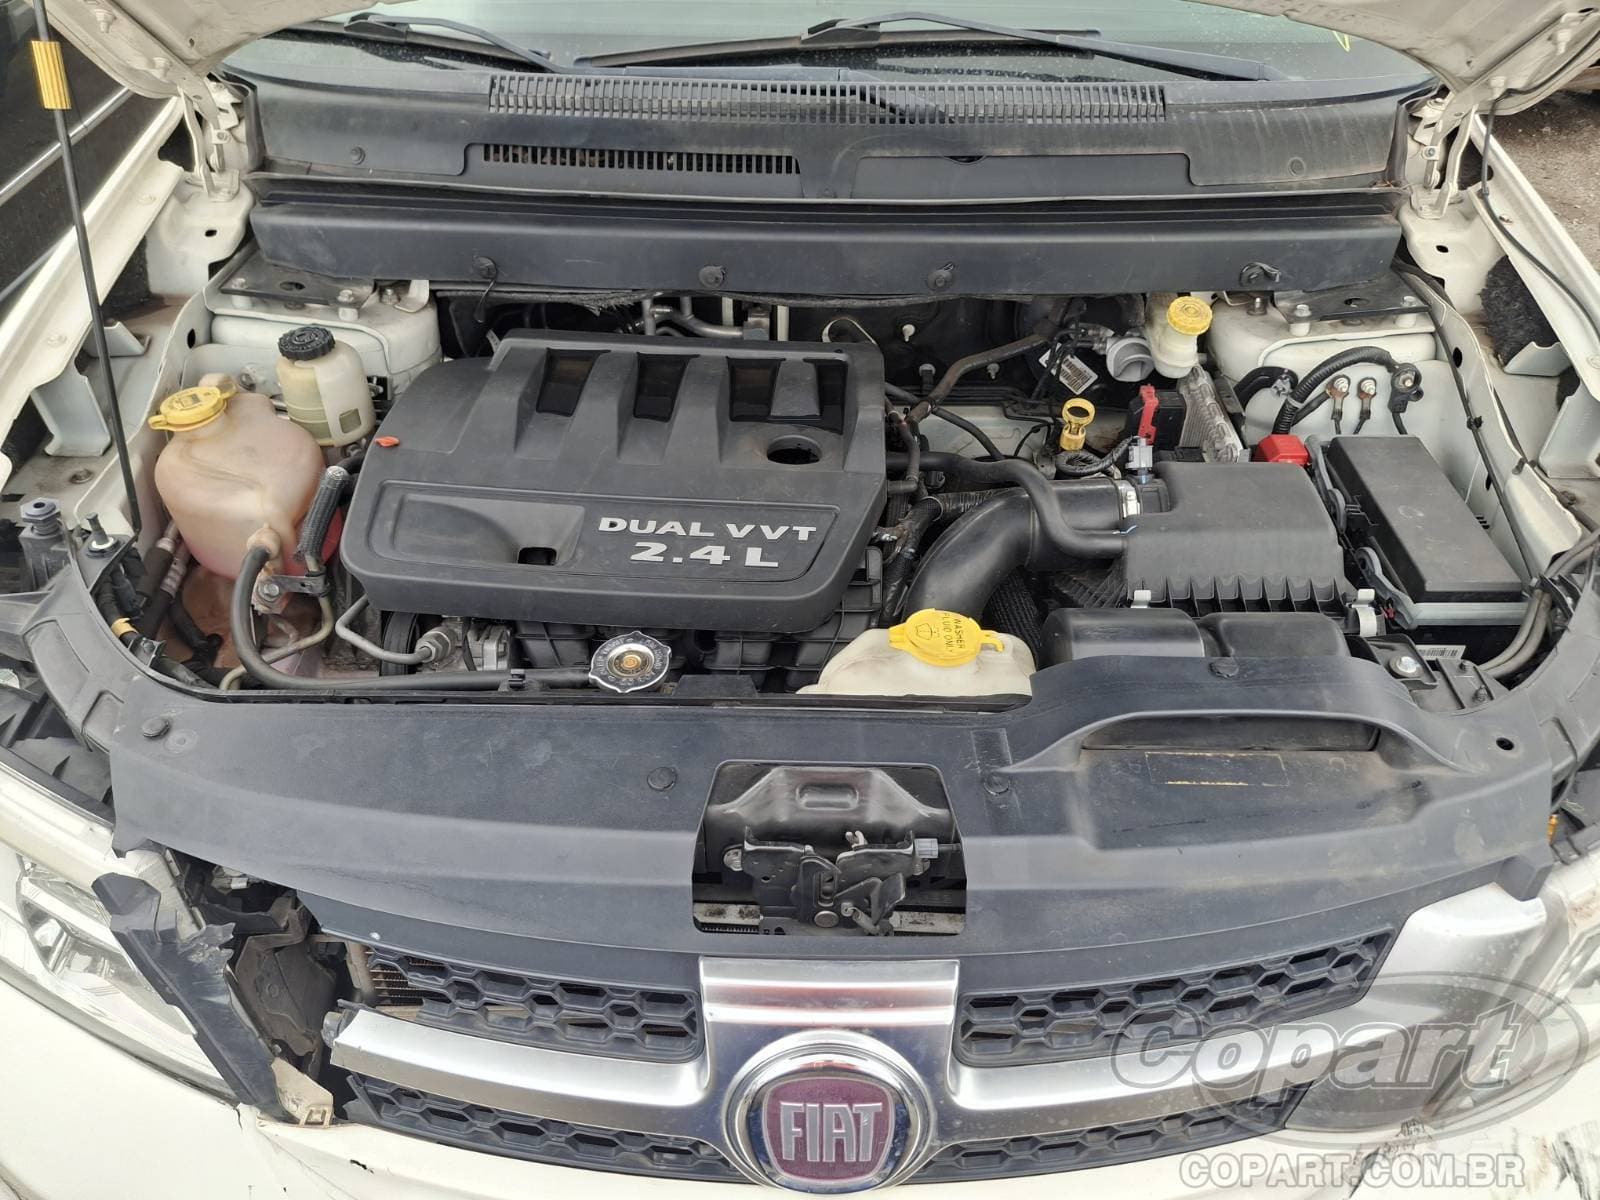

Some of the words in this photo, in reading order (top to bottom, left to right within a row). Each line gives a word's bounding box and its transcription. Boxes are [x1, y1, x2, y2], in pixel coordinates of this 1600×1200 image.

[598, 517, 715, 537] DUAL
[726, 523, 817, 541] VVT
[630, 541, 731, 565] 2.4
[744, 547, 779, 568] L
[953, 618, 966, 649] WASHER
[780, 1101, 883, 1163] FIAT
